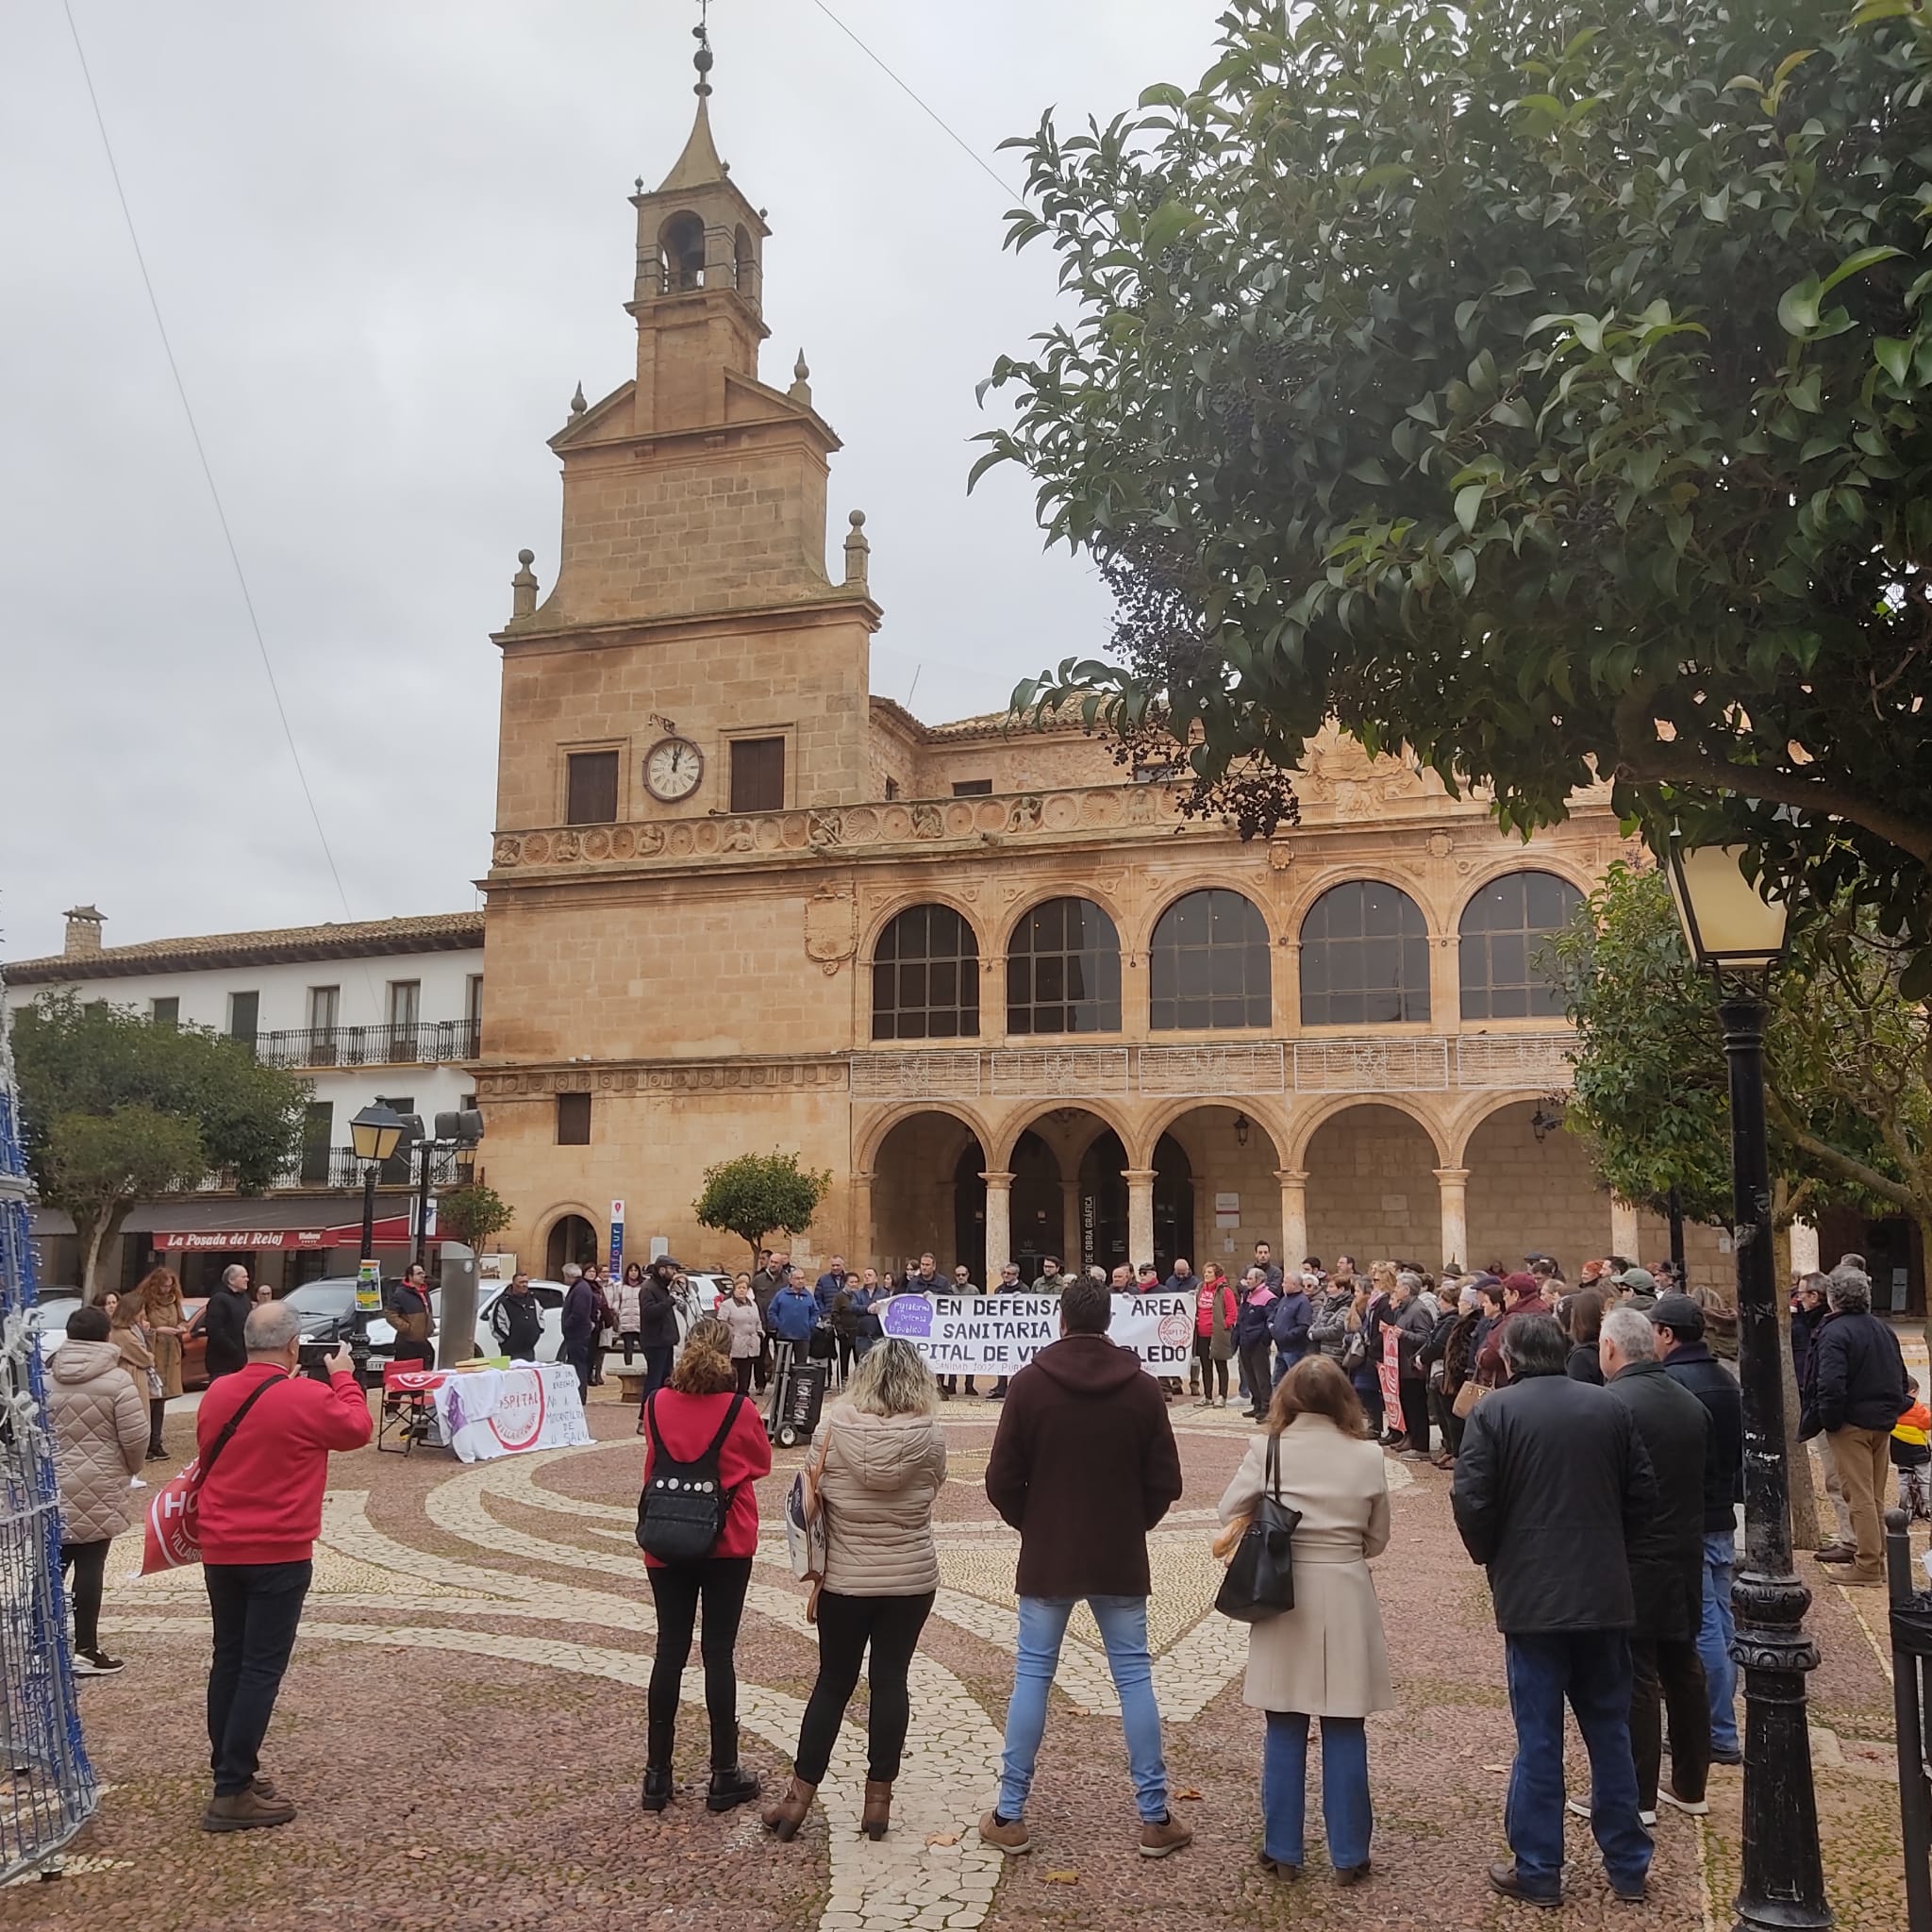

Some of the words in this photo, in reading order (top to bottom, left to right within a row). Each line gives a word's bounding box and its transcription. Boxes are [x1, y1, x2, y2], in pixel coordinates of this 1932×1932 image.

[1082, 1196, 1093, 1228] GRÁFICA
[168, 1234, 182, 1246] La
[187, 1233, 226, 1246] Posada
[229, 1232, 247, 1244] del
[251, 1231, 285, 1245] Reloj
[1085, 1229, 1093, 1251] OBRA
[1085, 1253, 1093, 1263] DE
[936, 1298, 962, 1316] EN
[974, 1298, 1061, 1317] DEFENSA
[1131, 1298, 1187, 1316] AREA
[943, 1321, 1052, 1340] SANITARIA
[983, 1345, 1008, 1362] DE
